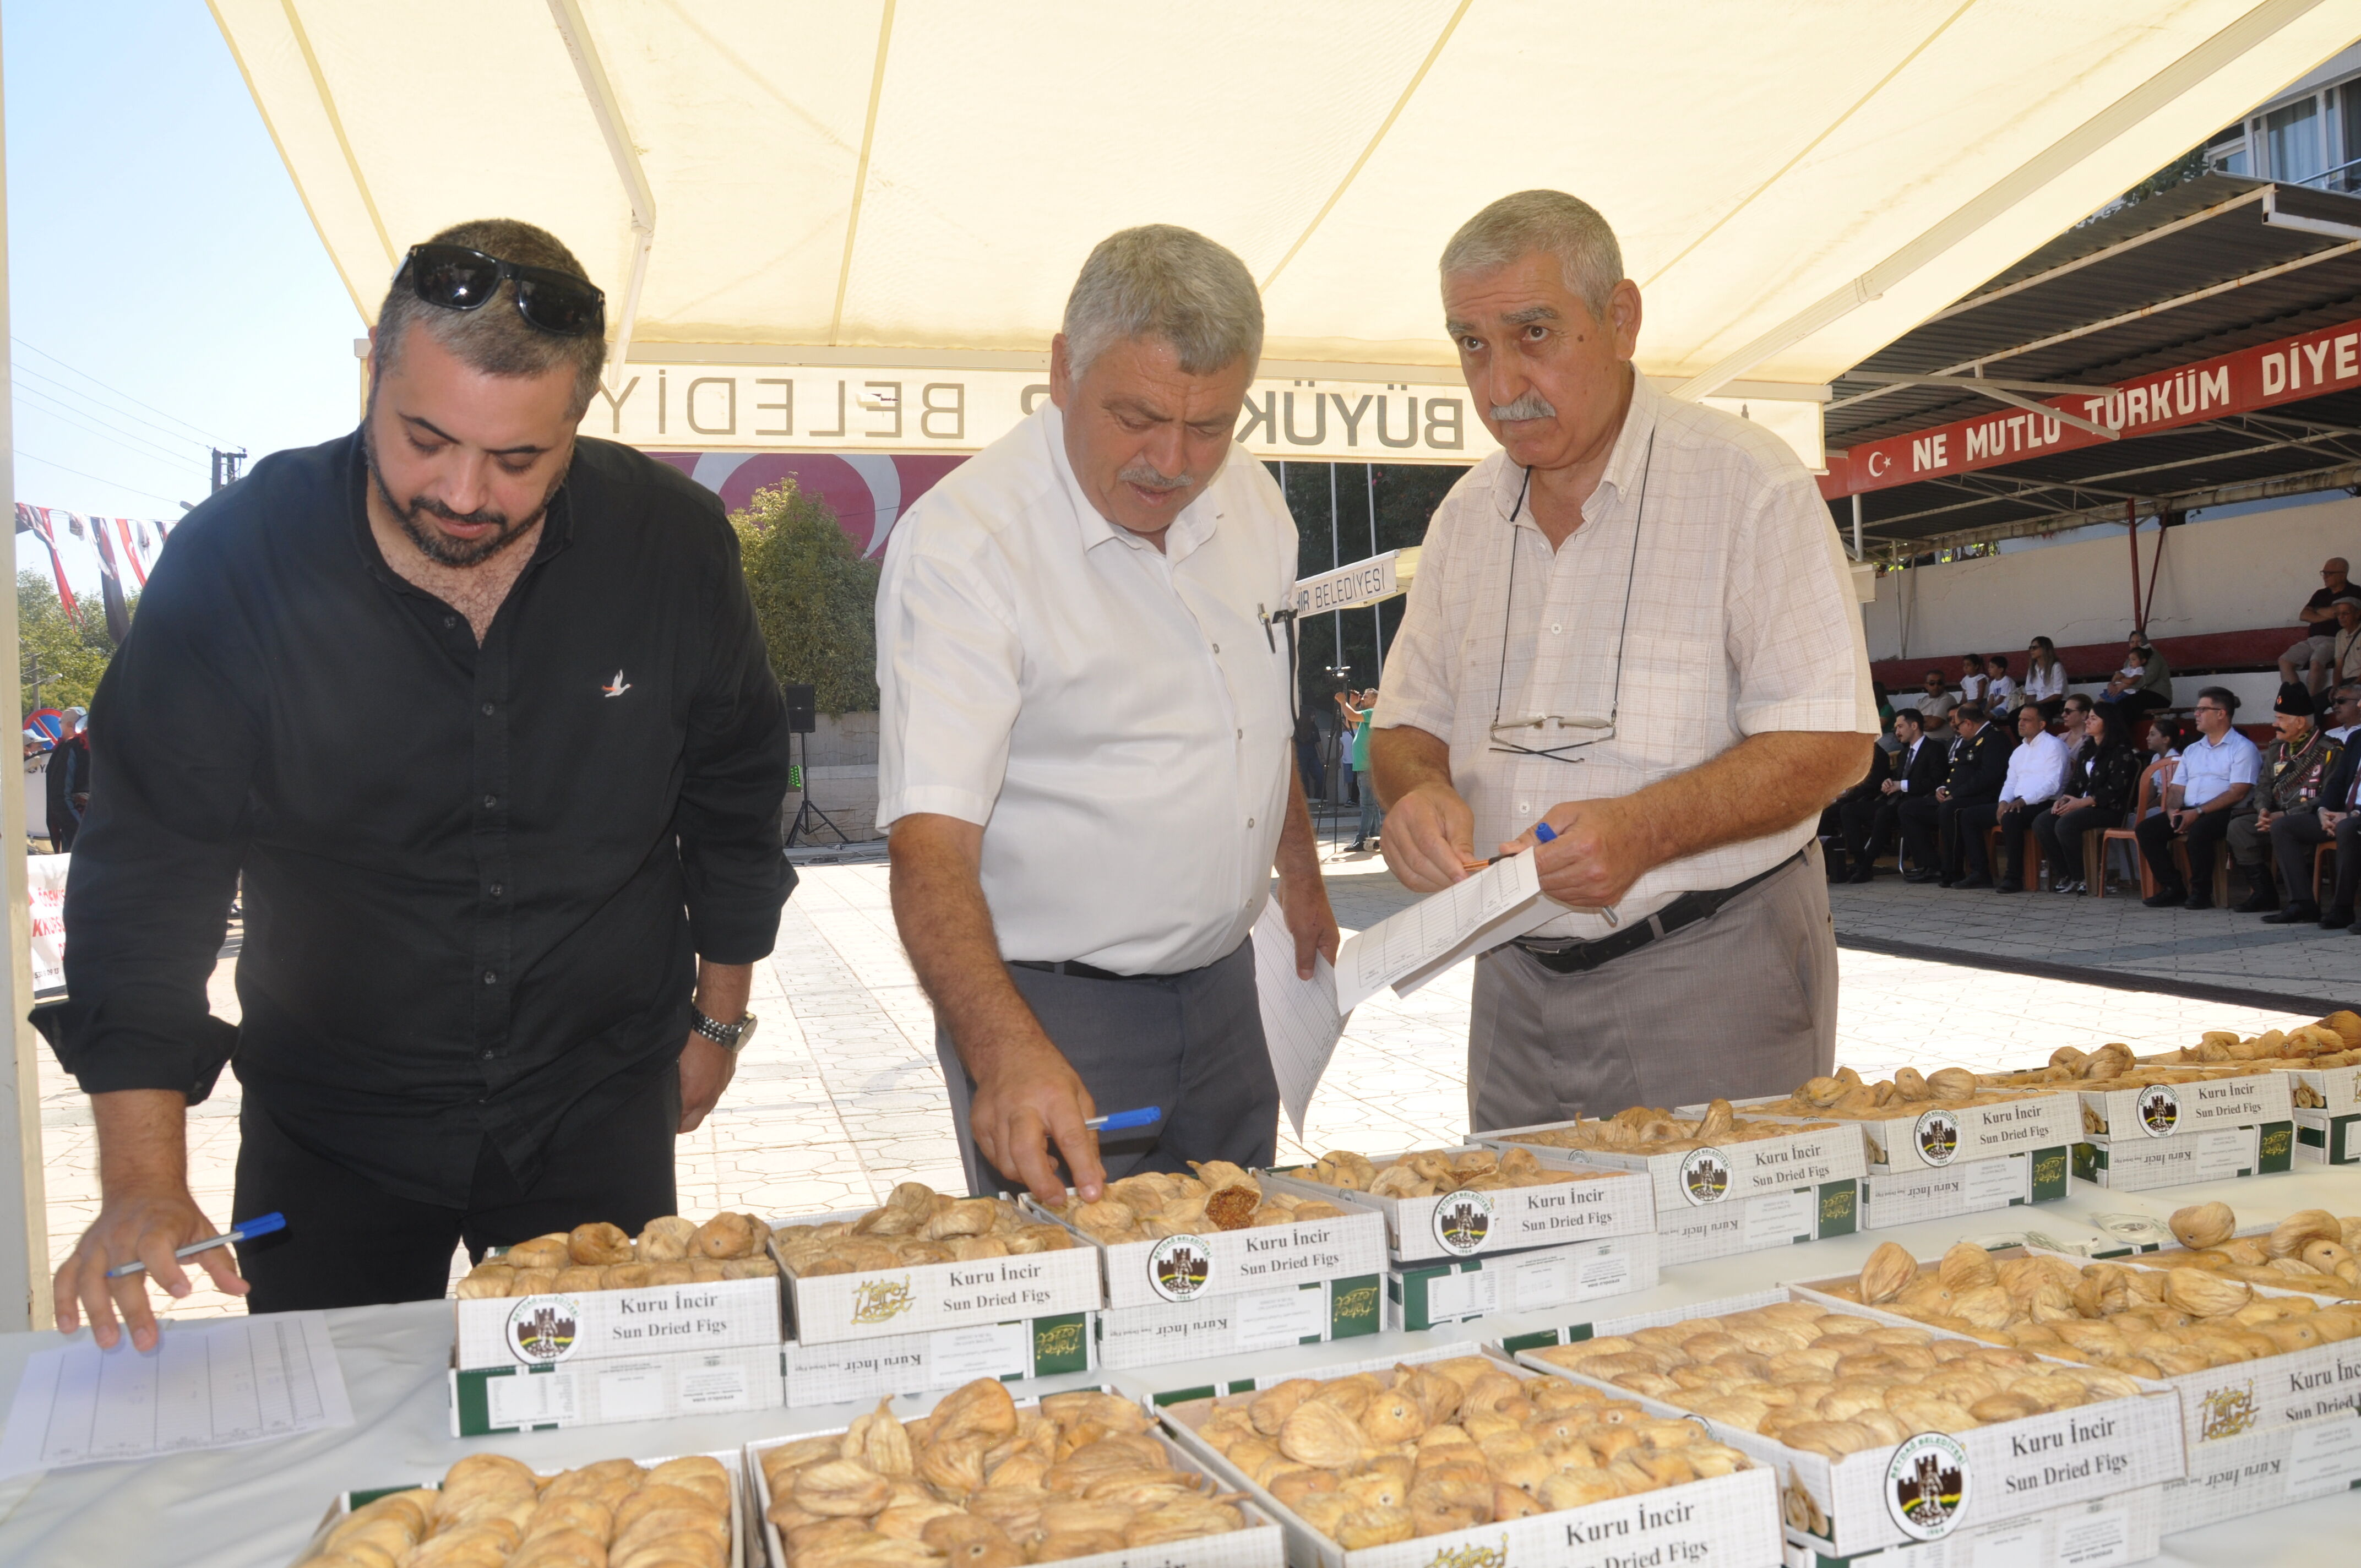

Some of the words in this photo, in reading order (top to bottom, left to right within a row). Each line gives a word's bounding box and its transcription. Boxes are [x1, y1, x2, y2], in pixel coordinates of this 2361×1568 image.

[1912, 433, 1948, 472] NE
[1966, 407, 2060, 461] MUTLU
[2262, 332, 2361, 396] DİYE
[1315, 564, 1385, 608] BELEDİYESİ
[2199, 1088, 2227, 1100] Kuru
[2229, 1082, 2255, 1096] İncir
[1983, 1112, 2012, 1125] Kuru
[2015, 1105, 2042, 1120] İncir
[2196, 1108, 2213, 1118] Sun
[2216, 1104, 2241, 1116] Dried
[2244, 1102, 2262, 1114] Figs
[1980, 1134, 1999, 1145] Sun
[2001, 1128, 2027, 1141] Dried
[2030, 1125, 2049, 1138] Figs
[1755, 1153, 1788, 1166] Kuru
[1792, 1145, 1821, 1160] İncir
[2168, 1151, 2191, 1161] Kuru
[1753, 1175, 1773, 1188] Sun
[1776, 1169, 1805, 1183] Dried
[1808, 1166, 1830, 1179] Figs
[1934, 1182, 1959, 1193] Kuru
[1438, 1194, 1458, 1216] BEYDAĞ
[1459, 1192, 1493, 1215] BELEDİYESİ
[1527, 1195, 1565, 1210] Kuru
[1570, 1188, 1604, 1205] İncir
[1522, 1220, 1546, 1233] Sun
[1550, 1214, 1584, 1229] Dried
[1587, 1211, 1612, 1226] Figs
[1711, 1219, 1738, 1231] Kuru
[1246, 1237, 1287, 1253] Kuru
[1293, 1229, 1331, 1246] İncir
[950, 1271, 994, 1287] Kuru
[1000, 1262, 1042, 1281] İncir
[1241, 1263, 1266, 1276] Sun
[1271, 1256, 1308, 1272] Dried
[1313, 1253, 1340, 1268] Figs
[539, 1296, 580, 1318] EDİYESİ
[621, 1298, 668, 1314] Kuru
[676, 1291, 718, 1309] İncir
[943, 1299, 972, 1312] Sun
[976, 1292, 1016, 1308] Dried
[1022, 1288, 1051, 1305] Figs
[613, 1326, 642, 1340] Sun
[648, 1321, 691, 1337] Dried
[697, 1319, 727, 1335] Figs
[1193, 1318, 1228, 1330] Kuru
[884, 1353, 922, 1368] Kuru
[2289, 1371, 2332, 1392] Kuru
[2337, 1358, 2361, 1381] İnc
[2286, 1407, 2312, 1421] Sun
[2011, 1431, 2064, 1457] Kuru
[2070, 1417, 2116, 1444] İncir
[2006, 1474, 2038, 1494] Sun
[2044, 1458, 2090, 1485] Dried
[2095, 1453, 2129, 1475] Figs
[2205, 1469, 2239, 1488] İncir
[2244, 1459, 2281, 1477] Kuru
[1565, 1518, 1629, 1547] Kuru
[1638, 1502, 1696, 1531] İncir
[1604, 1546, 1661, 1568] Dried
[1668, 1540, 1709, 1564] Figs
